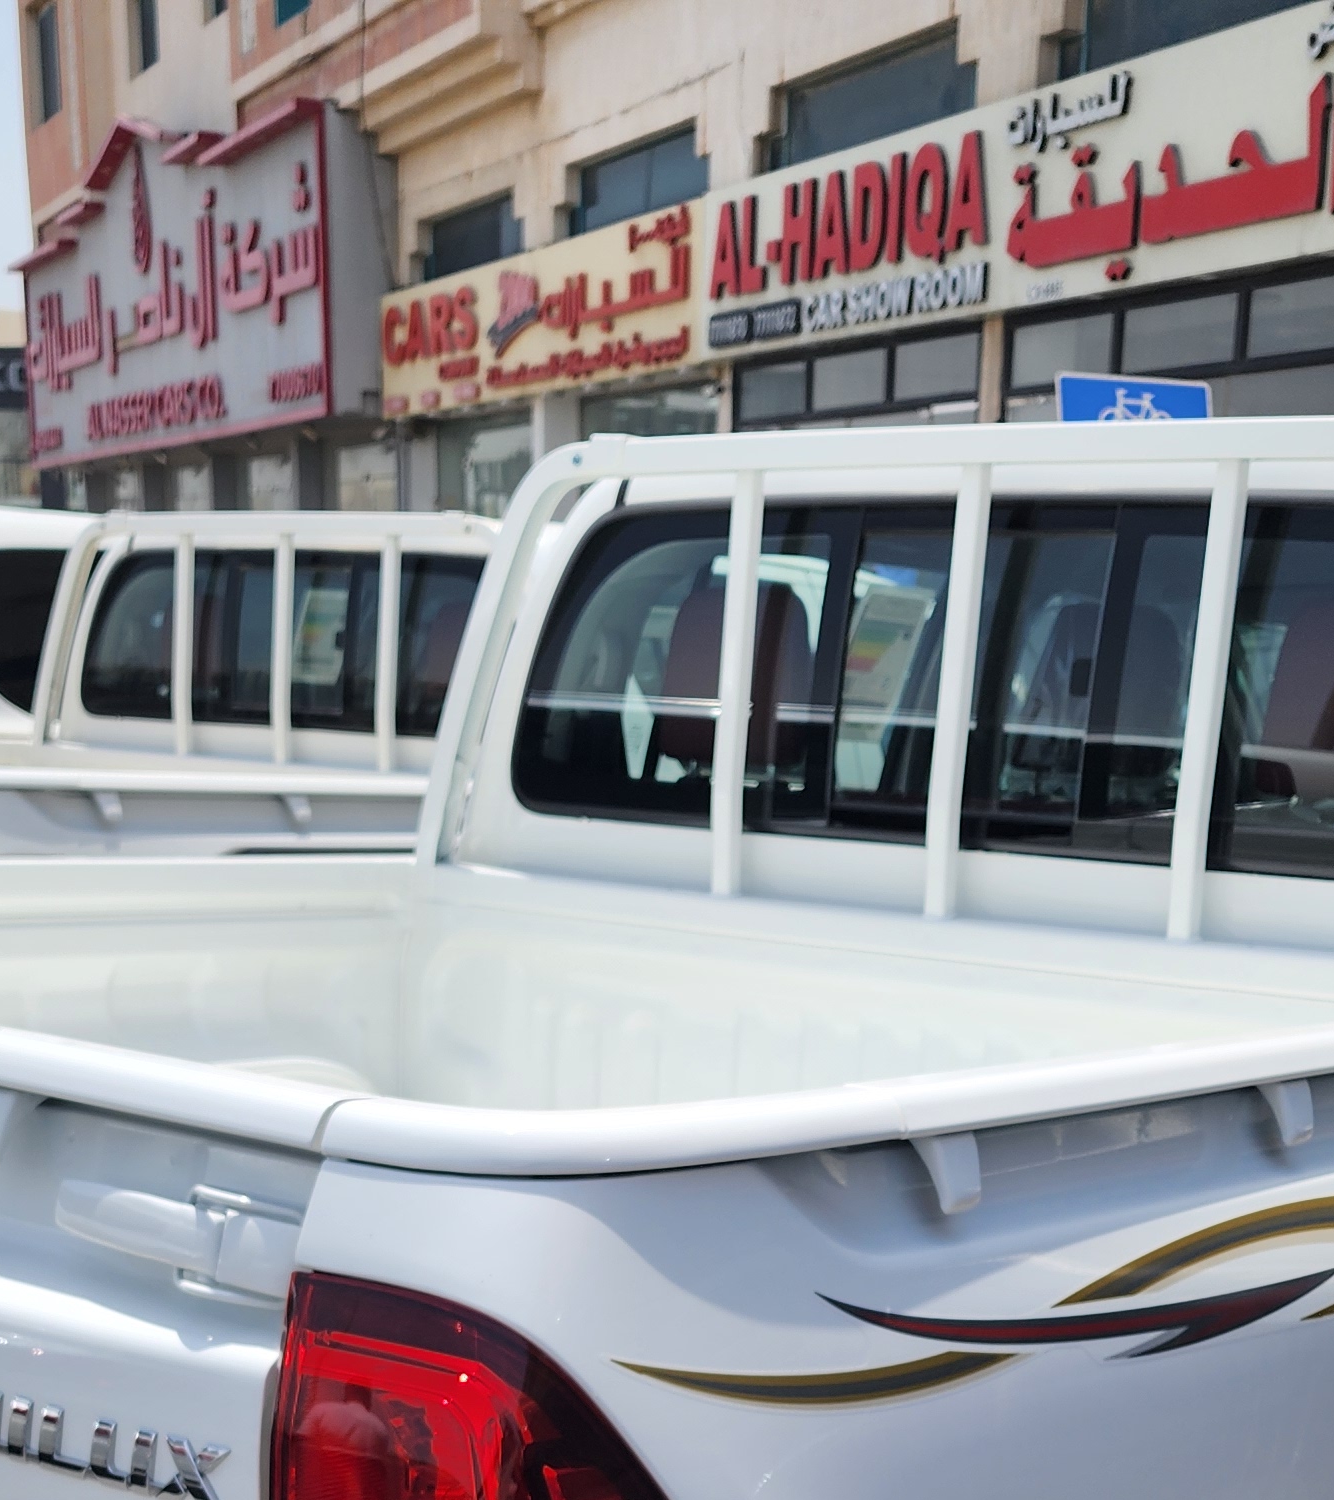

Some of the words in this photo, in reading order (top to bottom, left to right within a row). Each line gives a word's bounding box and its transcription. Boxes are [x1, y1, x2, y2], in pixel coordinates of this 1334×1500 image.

[221, 162, 318, 326] شركة
[709, 130, 986, 300] AL-HADIQA
[383, 286, 477, 367] CARS
